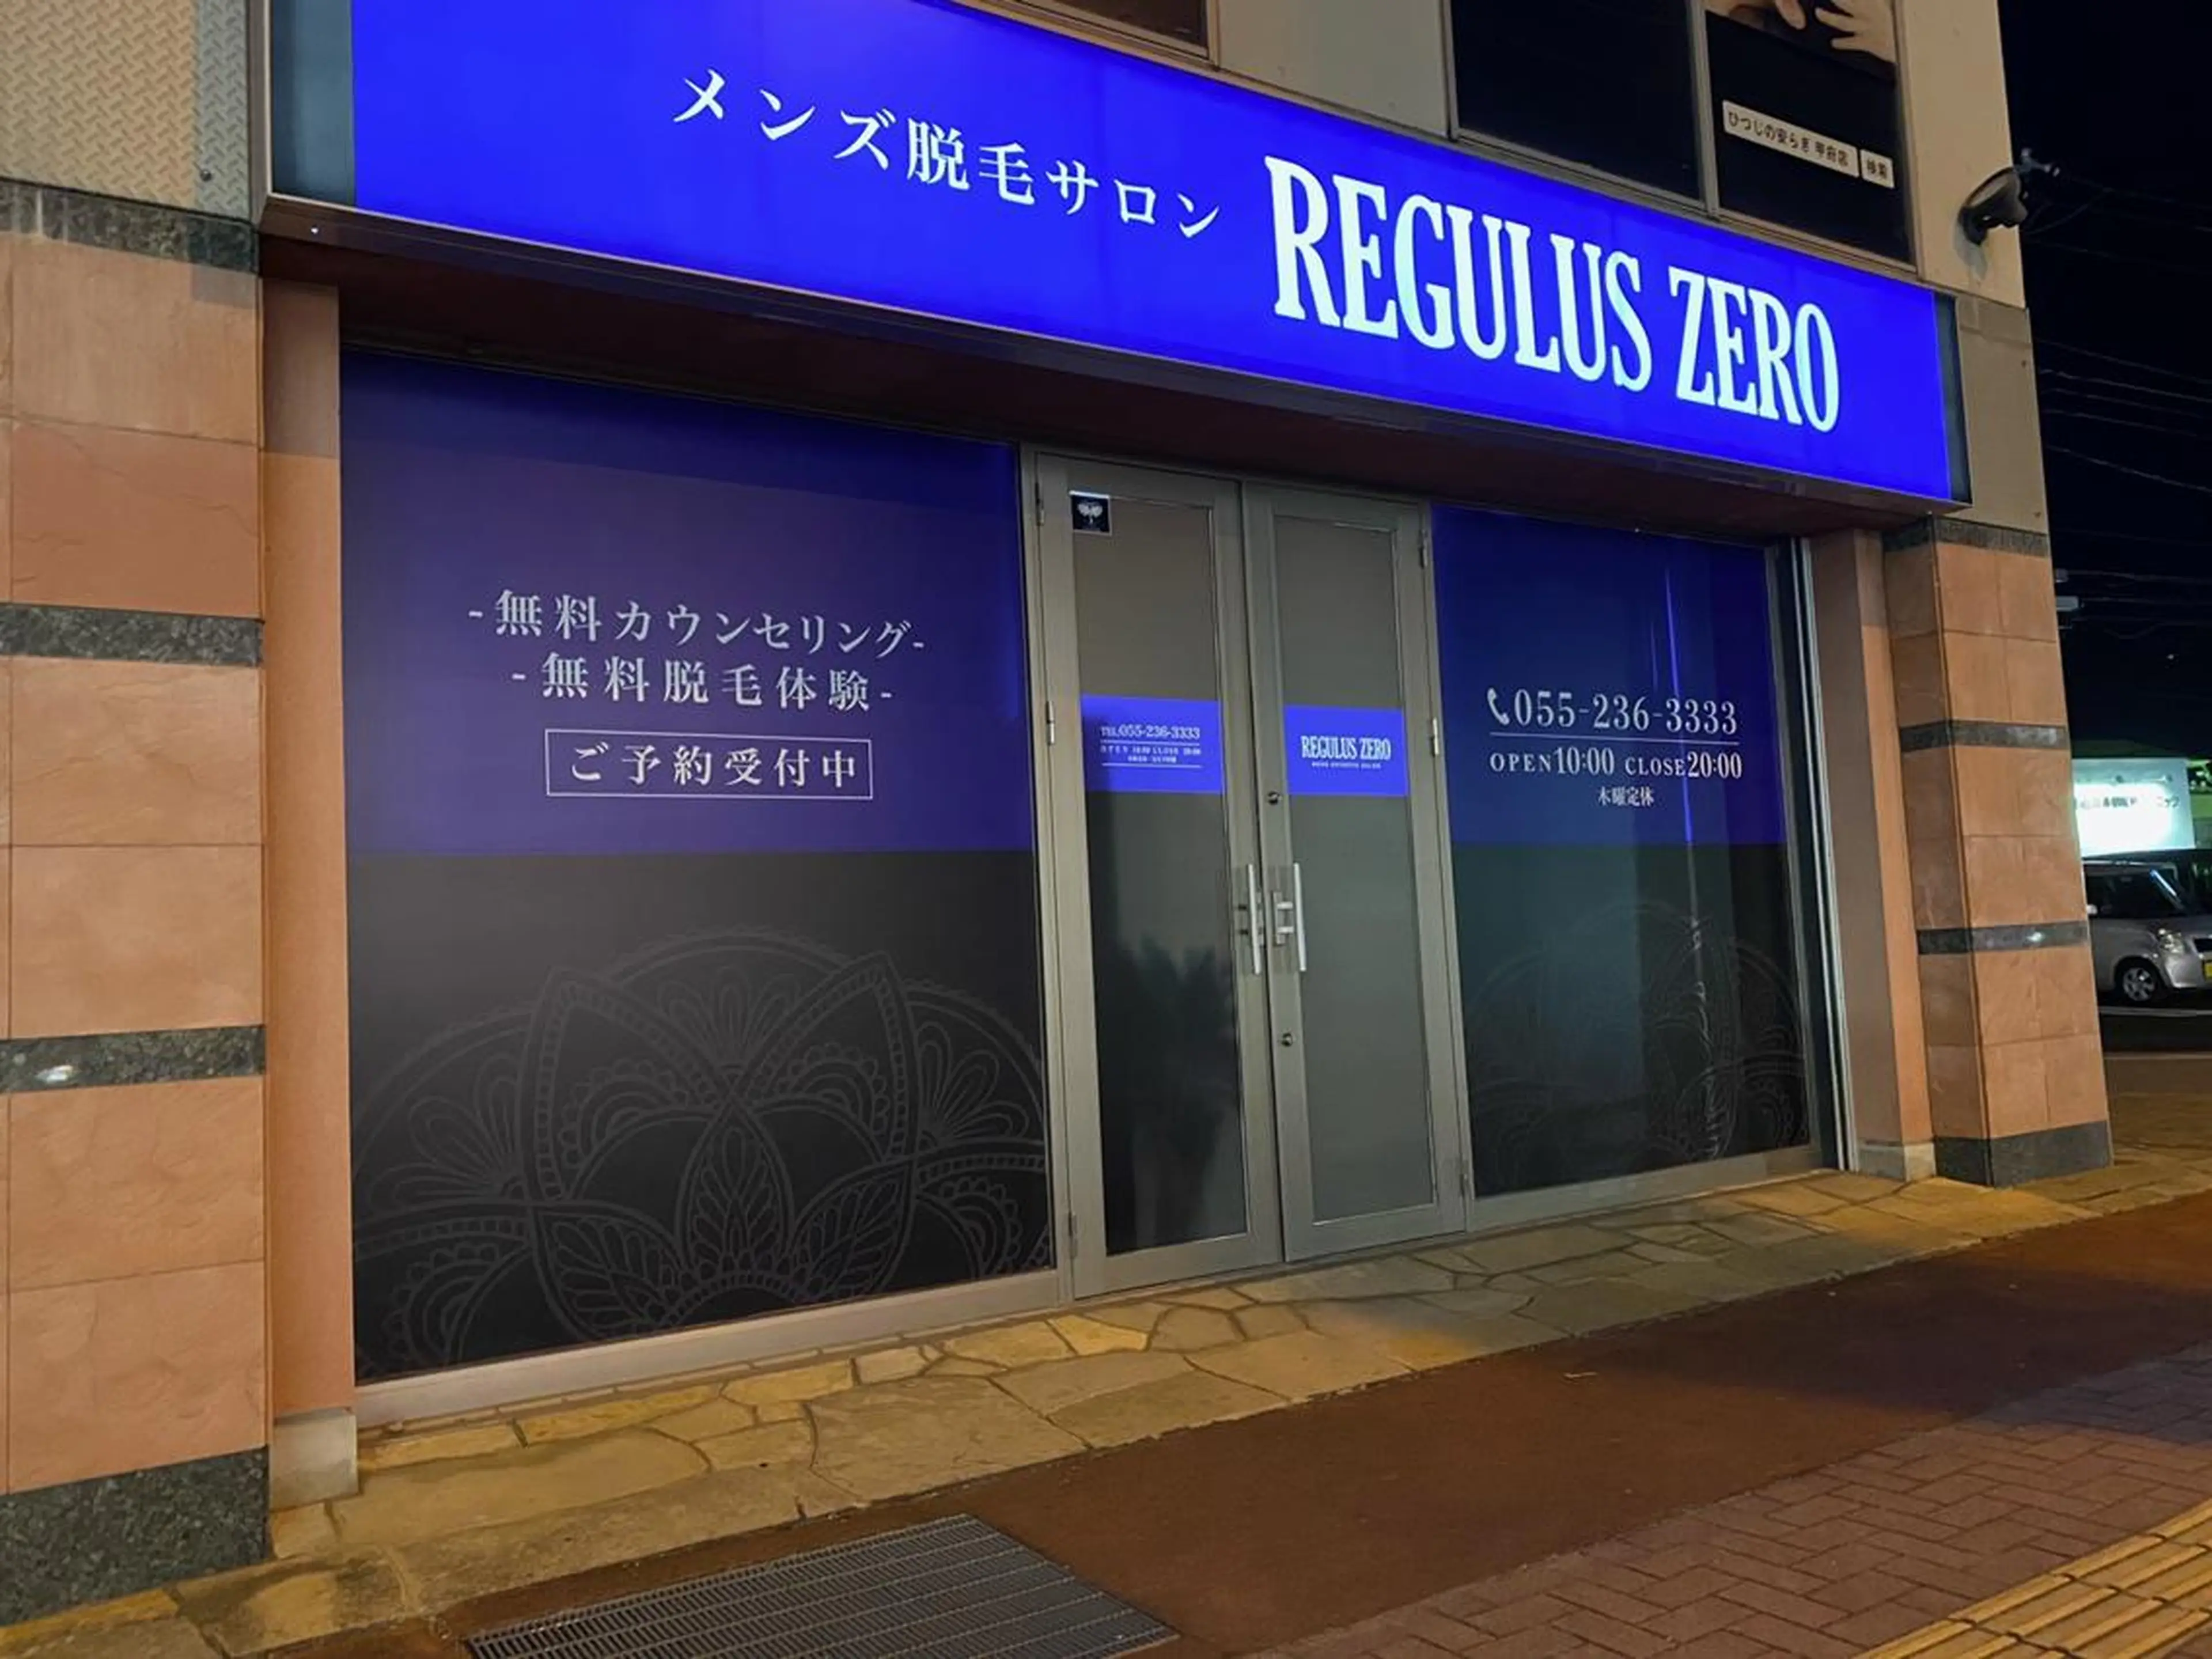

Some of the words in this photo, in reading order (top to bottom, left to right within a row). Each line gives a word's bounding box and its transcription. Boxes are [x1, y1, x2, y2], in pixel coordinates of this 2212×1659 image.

[673, 68, 1220, 238] メンズ脱毛サロン
[1264, 156, 1652, 392] REGULUS
[1668, 266, 1839, 432] ZERO
[1514, 689, 1737, 735] 055-236-3333
[570, 741, 856, 788] ご予約受付中
[1300, 735, 1358, 760] REGULUS
[1359, 737, 1391, 761] ZERO
[1597, 786, 1654, 806] 木曜定休
